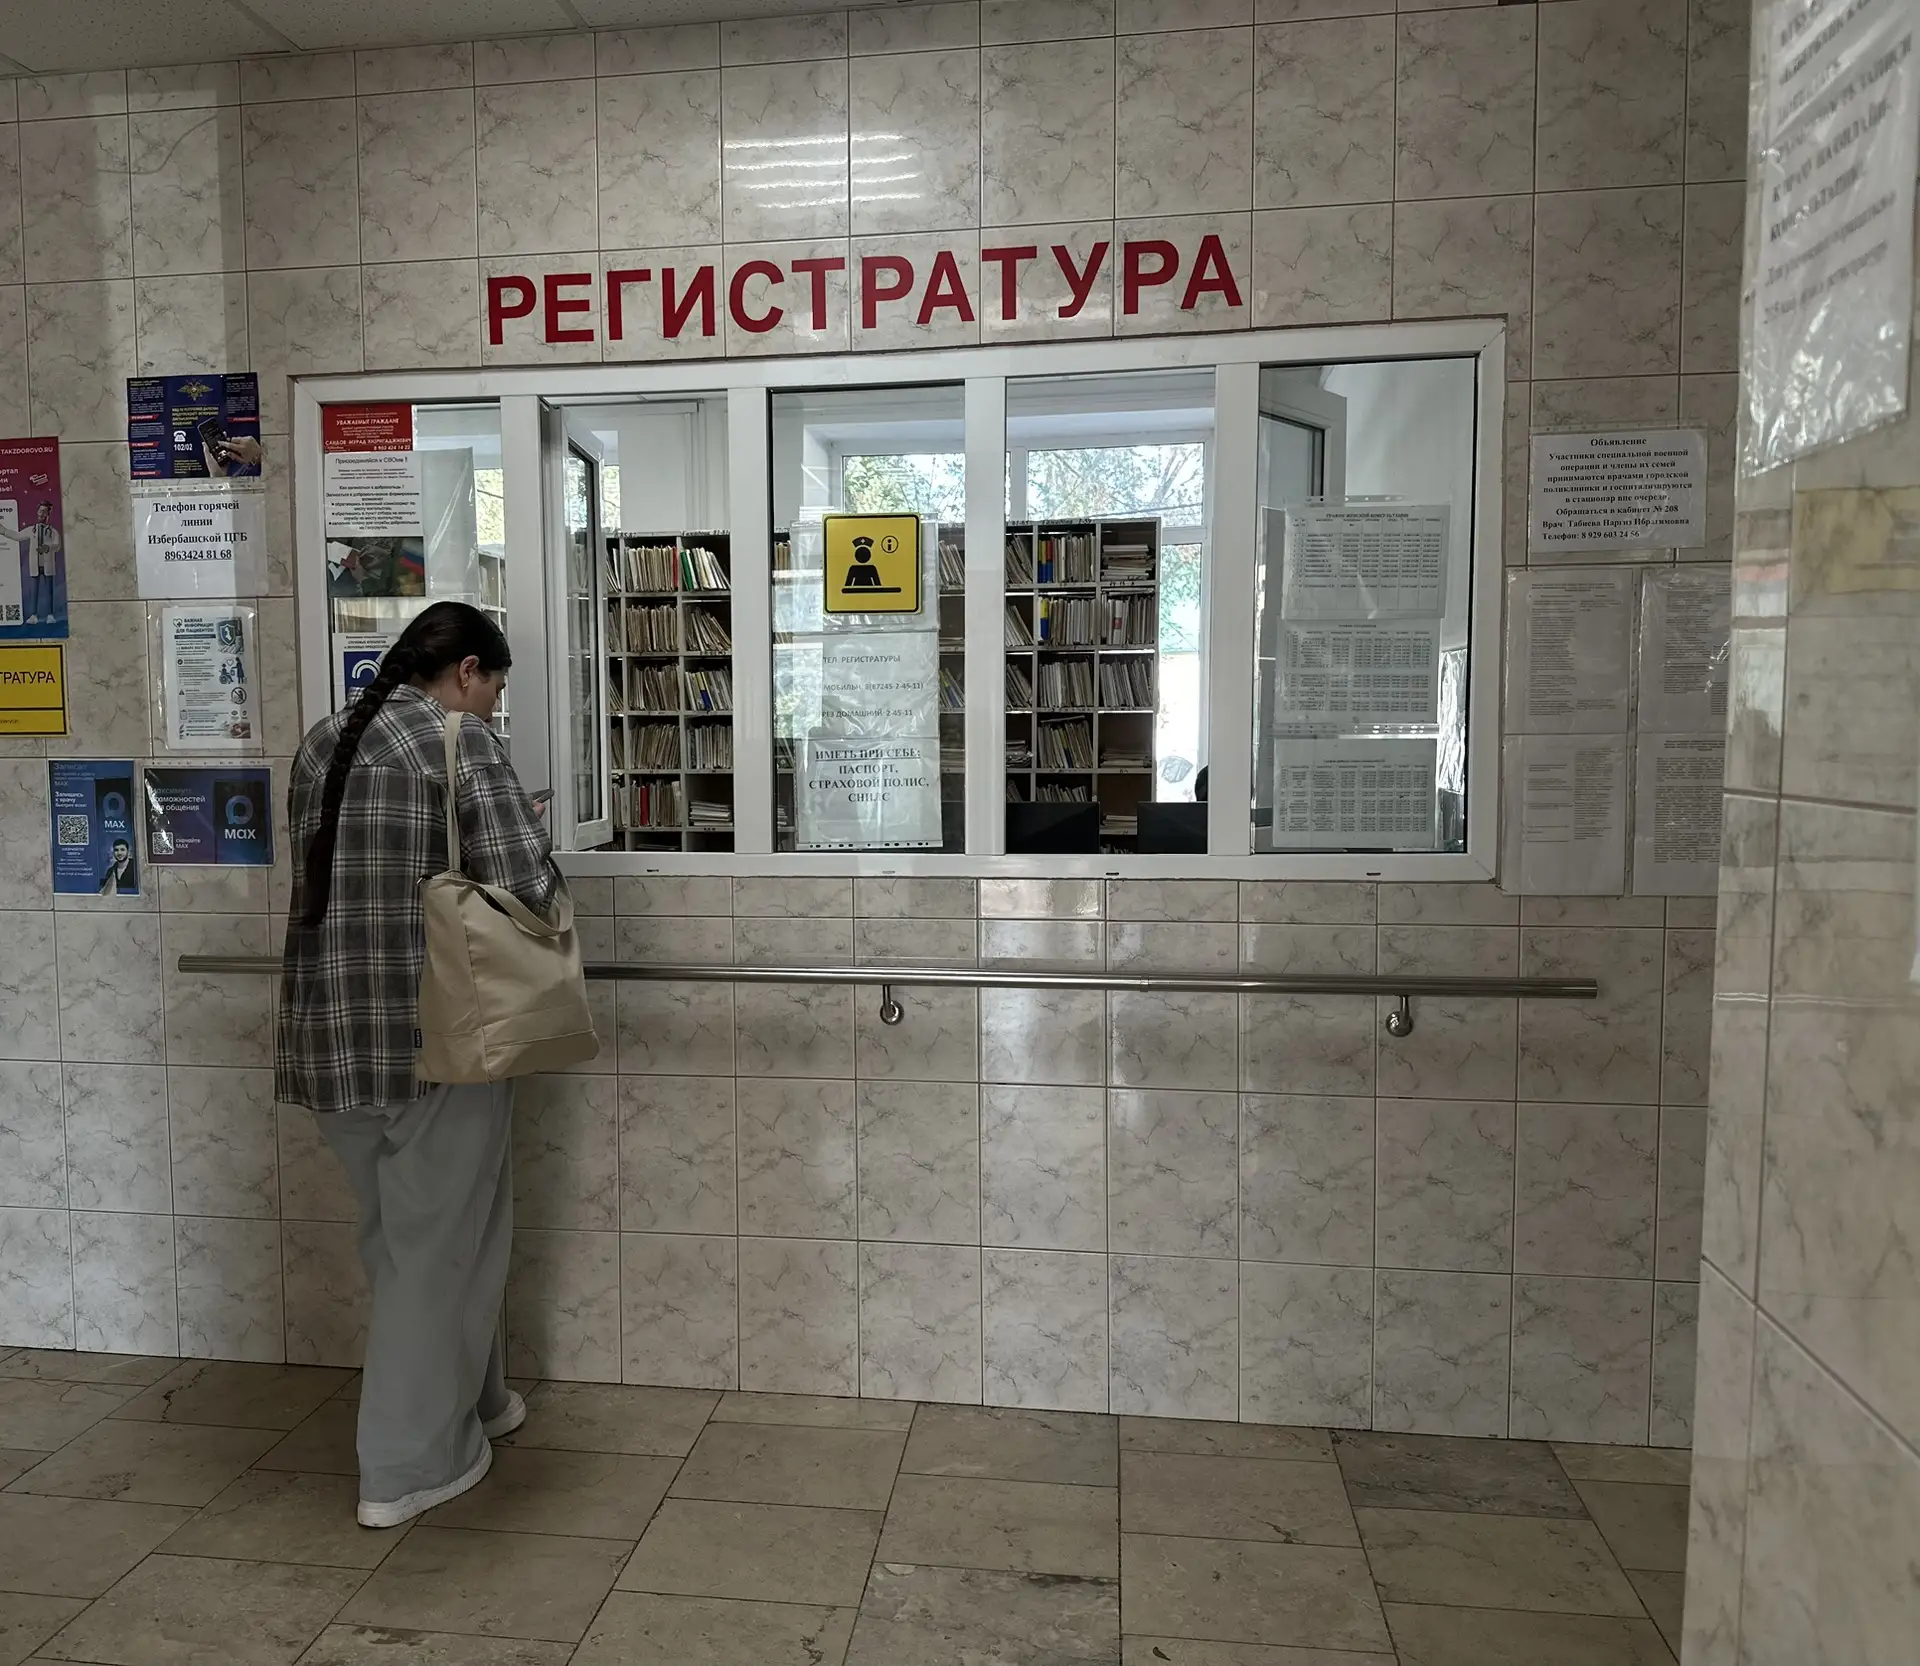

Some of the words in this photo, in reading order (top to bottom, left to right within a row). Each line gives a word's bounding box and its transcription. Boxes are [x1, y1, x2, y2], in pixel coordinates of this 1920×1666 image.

[487, 233, 1244, 346] РЕГИСТРАТУРА
[173, 443, 193, 451] 102/02
[1590, 438, 1647, 447] Объявление
[1549, 452, 1595, 461] Участники
[1597, 449, 1652, 459] специальной
[1653, 448, 1689, 457] военной
[1560, 463, 1600, 472] операции
[1610, 462, 1637, 470] члены
[1651, 460, 1676, 468] семей
[1547, 474, 1605, 484] принимаются
[1607, 473, 1644, 481] врачами
[1646, 471, 1689, 481] городской
[1543, 485, 1600, 493] поликлиники
[1610, 482, 1693, 492] госпитализируются
[1572, 494, 1616, 504] стационар
[152, 502, 196, 514] Телефон
[198, 500, 240, 511] горячей
[1555, 508, 1608, 517] Обращаться
[1617, 505, 1651, 514] кабинет
[1652, 504, 1663, 512] №
[1664, 504, 1679, 512] 208
[180, 518, 213, 527] линии
[1567, 519, 1601, 528] Табиева
[1603, 518, 1633, 528] Наргиз
[148, 532, 221, 546] Избербашской
[224, 531, 248, 544] ЦГБ
[1542, 531, 1579, 541] Телефон:
[1581, 531, 1586, 539] 8
[1588, 531, 1602, 539] 929
[1619, 530, 1628, 538] 24
[164, 550, 204, 561] 8963424
[205, 550, 216, 561] 81
[219, 549, 232, 560] 68
[841, 655, 901, 664] РЕГИСТРАТУРЫ
[815, 750, 857, 761] ИМЕТЬ
[860, 749, 884, 760] ПРИ
[886, 748, 921, 759] СЕБЕ:
[809, 778, 881, 790] СТРАХОВОЙ
[165, 803, 200, 812] общения
[104, 820, 125, 828] MAX
